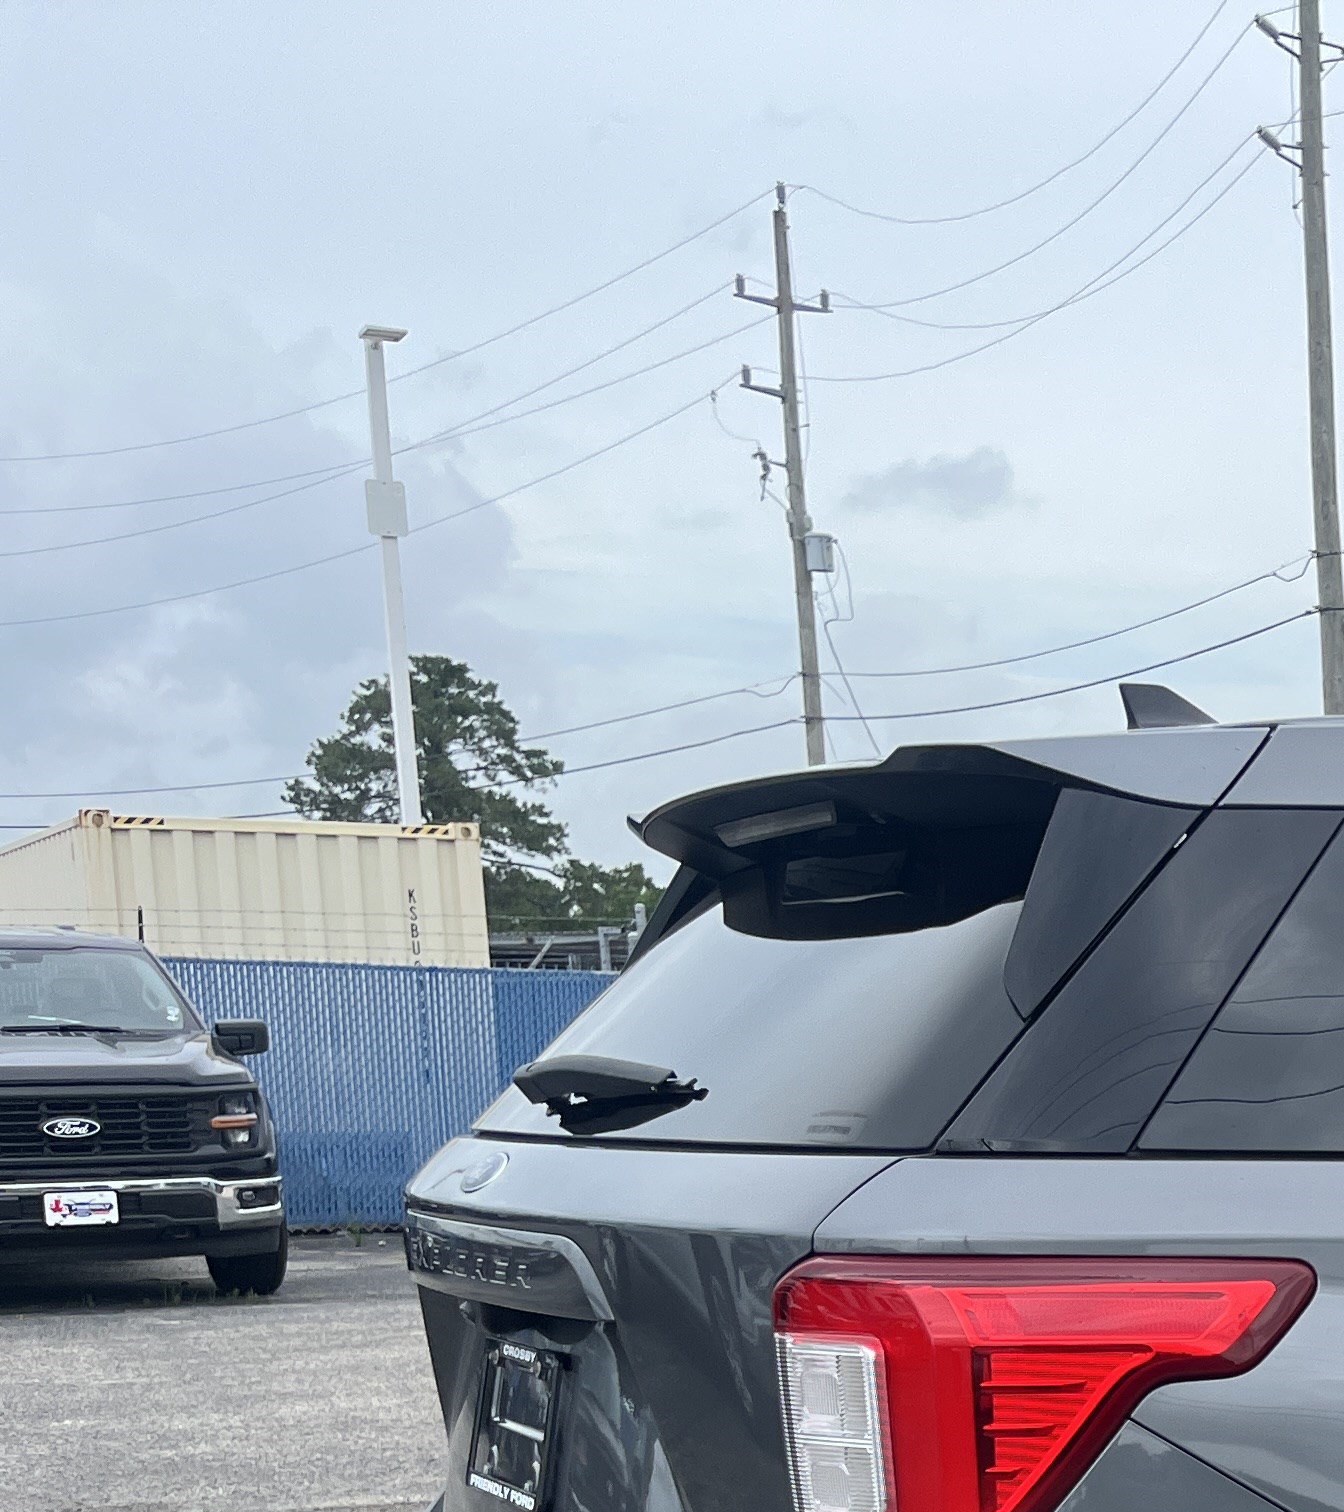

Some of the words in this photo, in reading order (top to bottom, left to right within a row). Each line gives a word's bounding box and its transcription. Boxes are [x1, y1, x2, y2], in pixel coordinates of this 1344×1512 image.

[407, 888, 421, 956] KSBU
[503, 1344, 537, 1363] CROSBY
[469, 1473, 510, 1500] FRIENDLY
[510, 1489, 535, 1511] FORD
